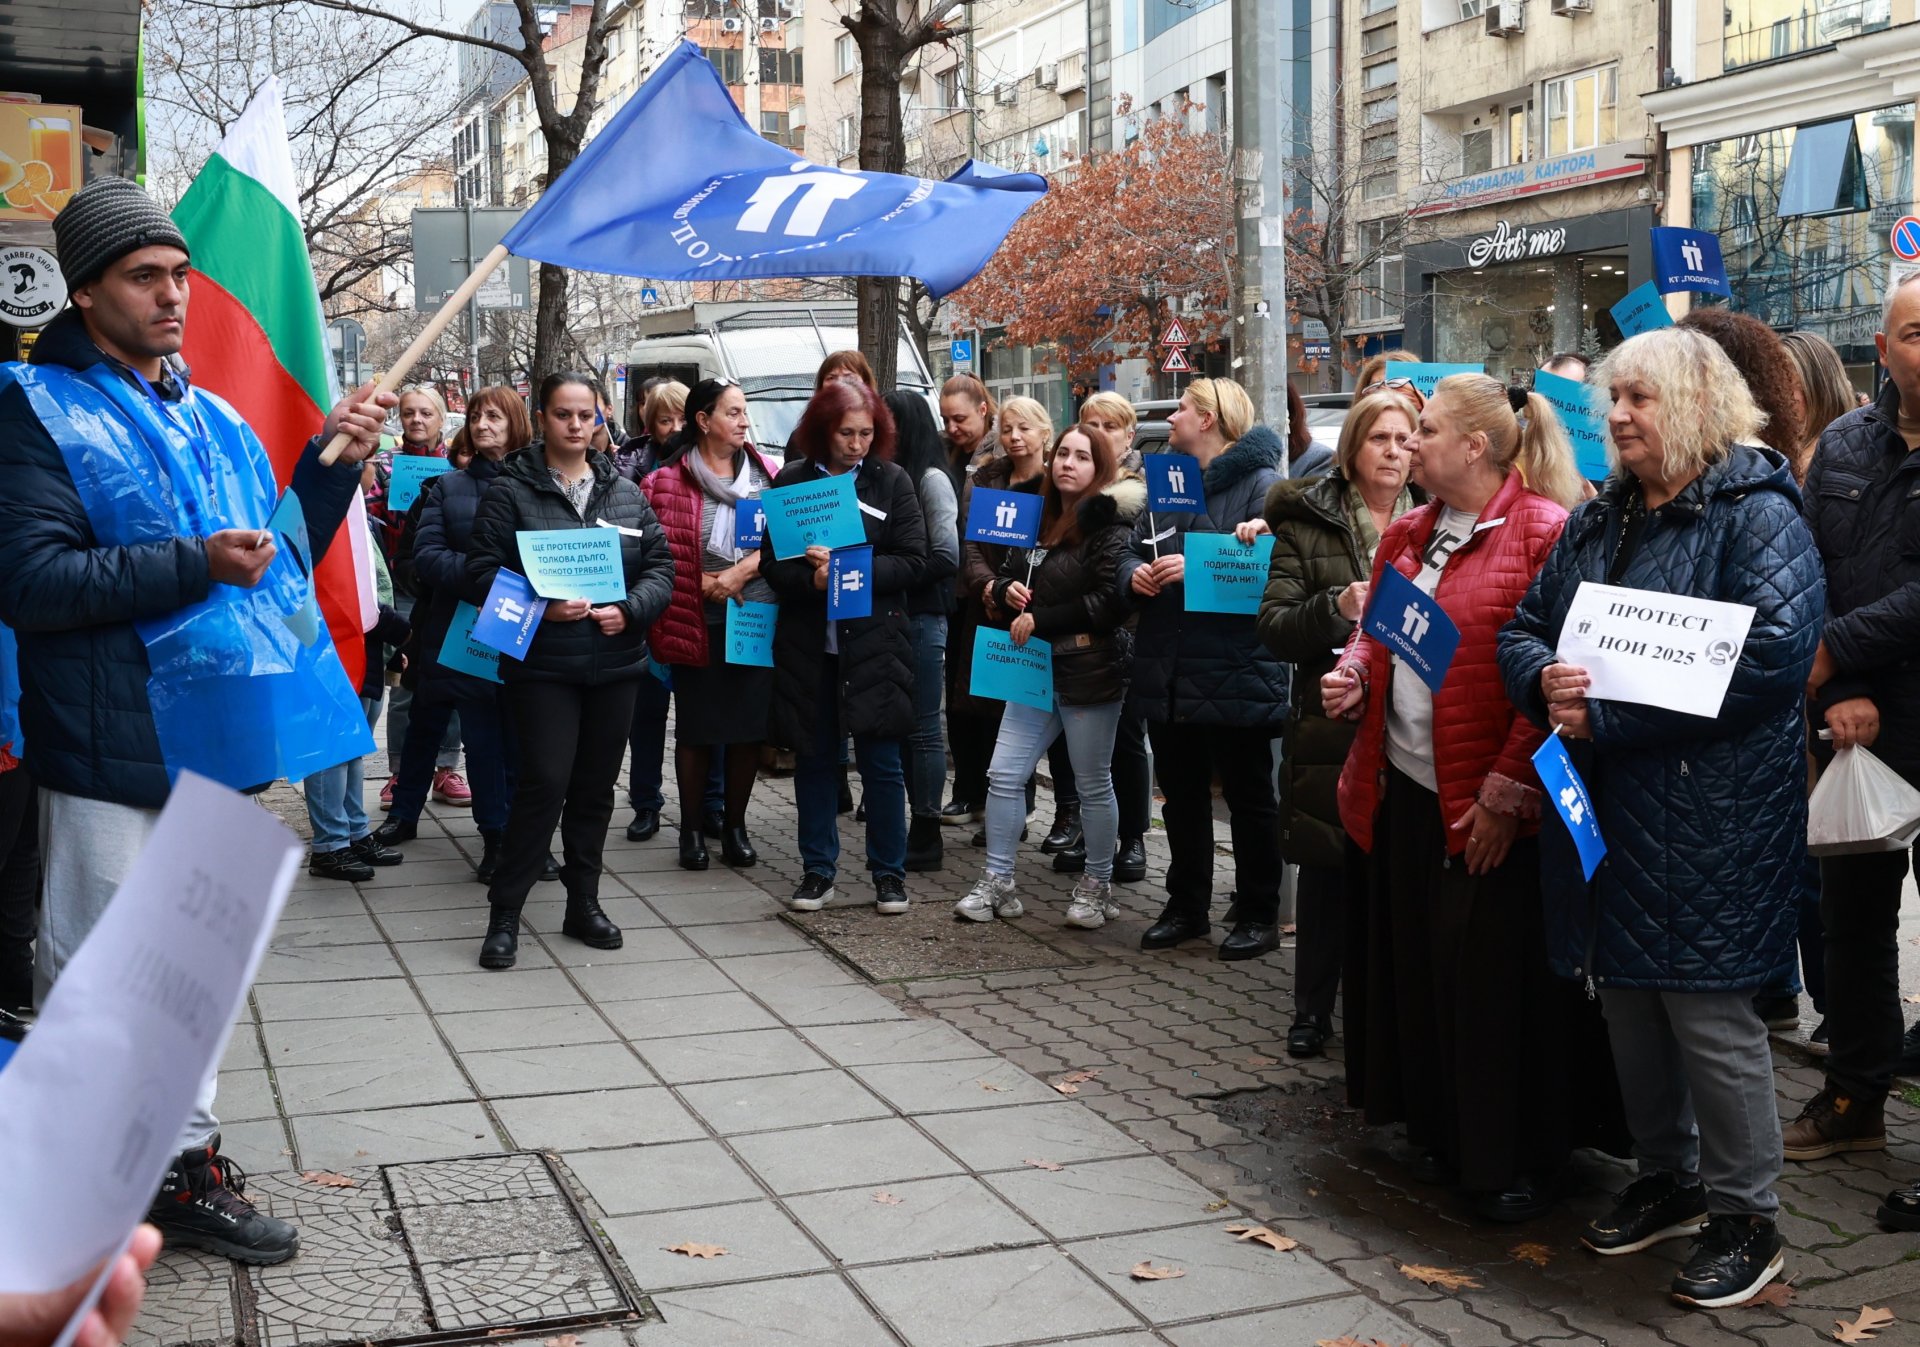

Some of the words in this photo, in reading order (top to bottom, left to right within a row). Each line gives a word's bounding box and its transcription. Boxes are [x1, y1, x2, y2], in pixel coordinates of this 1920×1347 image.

[1446, 168, 1525, 196] НОТАРИАЛНА
[1534, 153, 1596, 181] КАНТОРА
[1468, 219, 1527, 269] Art
[1529, 227, 1566, 257] me
[4, 251, 35, 262] BARBER
[36, 256, 55, 274] SHOP
[1668, 275, 1679, 284] КТ
[5, 305, 43, 316] PRINCE
[1417, 376, 1443, 384] НЯМ
[1565, 402, 1577, 414] ДА
[783, 489, 839, 507] ЗАСЛУЖАВАМЕ
[785, 501, 840, 517] СПРАВЕДЛИВИ
[796, 514, 834, 528] ЗАПЛАТИ!
[532, 544, 545, 552] ЩЕ
[546, 540, 612, 551] ПРОТЕСТИРАМЕ
[1217, 547, 1243, 557] ЗАЩО
[1244, 549, 1254, 557] СЕ
[538, 555, 576, 564] ТОЛКОВА
[577, 553, 609, 564] ДЪЛГО,
[834, 558, 840, 566] КТ
[538, 567, 573, 576] КОЛКОТО
[574, 564, 613, 574] ТРЯБВА!!!
[1203, 560, 1261, 571] ПОДИГРАВАТЕ
[1262, 563, 1268, 571] С
[1212, 573, 1239, 584] ТРУДА
[1239, 575, 1258, 584] НИ?!
[1607, 602, 1713, 632] ПРОТЕСТ
[1376, 620, 1388, 633] КТ
[515, 634, 524, 646] КТ
[986, 640, 1007, 653] СЛЕД
[1007, 644, 1047, 660] ПРОТЕСТИТЕ
[1598, 635, 1648, 657] НОИ
[1650, 645, 1697, 666] 2025
[986, 653, 1020, 665] СЛЕДВАТ
